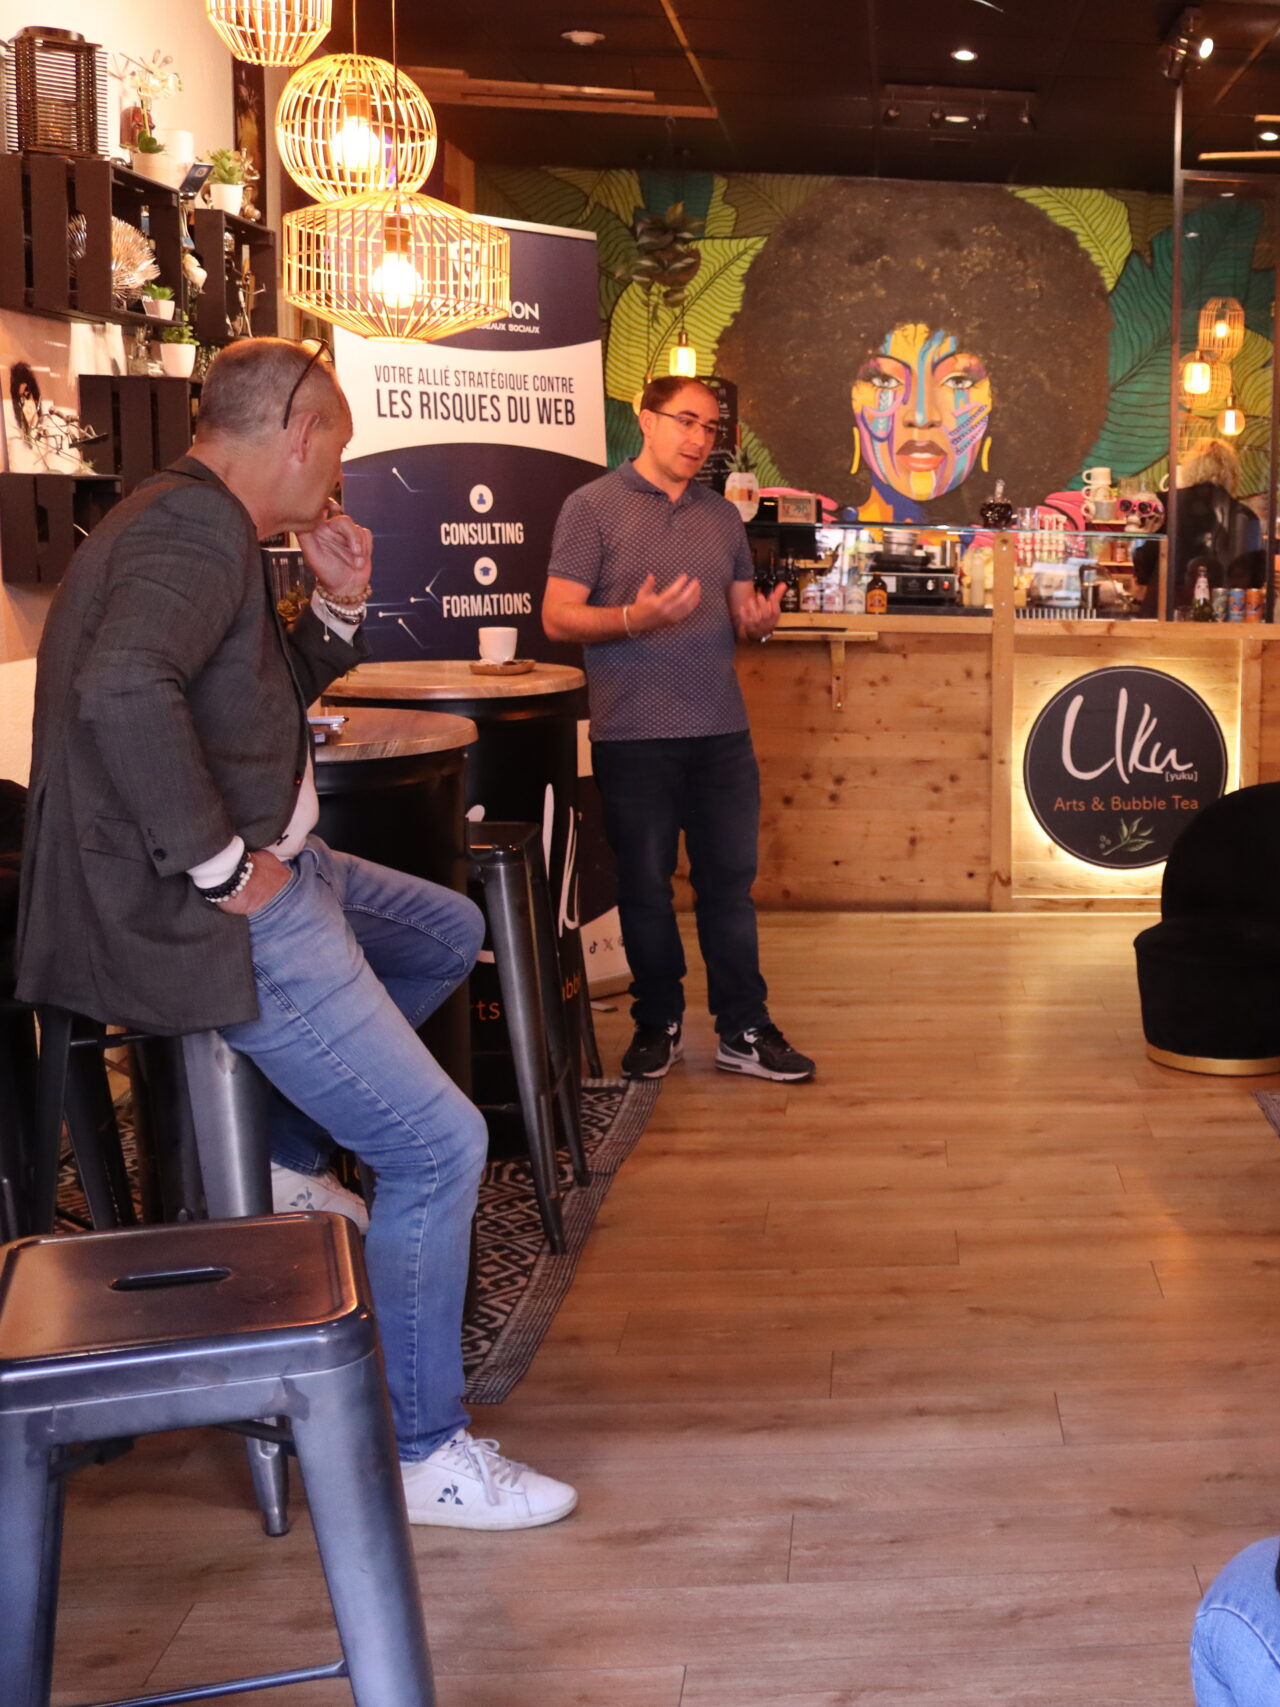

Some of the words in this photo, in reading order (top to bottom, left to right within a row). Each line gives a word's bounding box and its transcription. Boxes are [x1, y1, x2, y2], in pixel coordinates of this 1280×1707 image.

[508, 323, 541, 334] SOCIAUX
[374, 365, 413, 385] VOTRE
[417, 365, 451, 386] ALLIÉ
[454, 368, 529, 391] STRATÉGIQUE
[532, 375, 575, 394] CONTRE
[376, 388, 413, 419] LES
[420, 391, 501, 424] RISQUES
[508, 396, 531, 424] DU
[537, 397, 576, 426] WEB
[440, 522, 525, 545] CONSULTING
[442, 592, 532, 618] FORMATIONS
[1061, 687, 1194, 784] Uku
[1053, 796, 1086, 811] Arts
[1091, 796, 1105, 811] &
[1110, 795, 1167, 811] Bubble
[1172, 794, 1199, 811] Tea
